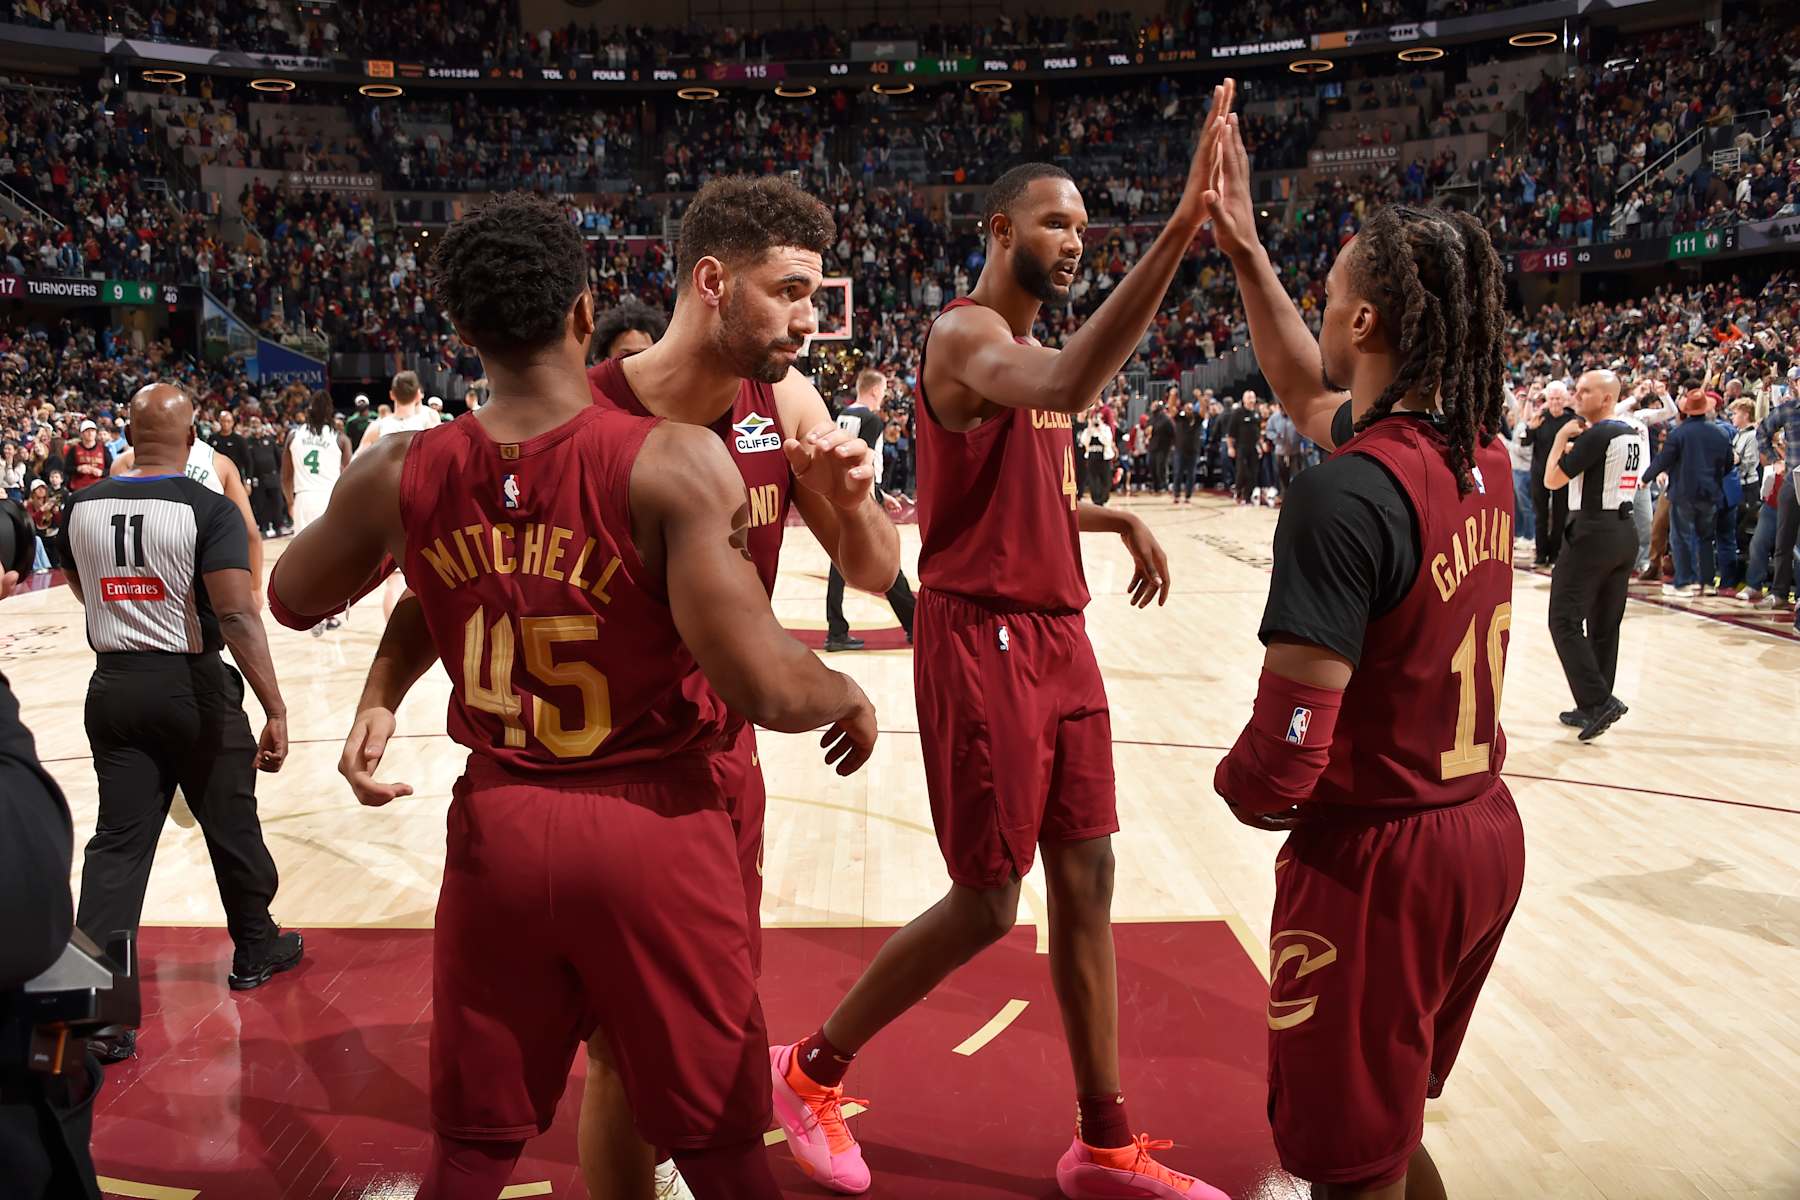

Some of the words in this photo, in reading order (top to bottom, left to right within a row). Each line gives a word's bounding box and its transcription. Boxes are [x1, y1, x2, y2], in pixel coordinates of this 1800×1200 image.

[829, 63, 849, 75] 0.0
[938, 60, 959, 72] 111
[1043, 57, 1078, 69] FOULS
[745, 65, 767, 78] 115
[1325, 146, 1397, 160] WESTFIELD
[303, 175, 374, 186] WESTFIELD
[1675, 237, 1696, 254] 111
[1544, 251, 1568, 268] 115
[27, 280, 98, 297] TURNOVERS
[113, 285, 124, 300] 9
[164, 292, 178, 303] 40
[737, 436, 779, 450] CLIFFS
[303, 449, 320, 474] 4
[1062, 444, 1078, 511] 4
[748, 483, 779, 528] ND
[111, 514, 145, 567] 11
[420, 523, 622, 605] MITCHELL
[106, 582, 159, 596] Emirates
[463, 605, 612, 758] 45
[1440, 601, 1512, 781] 10
